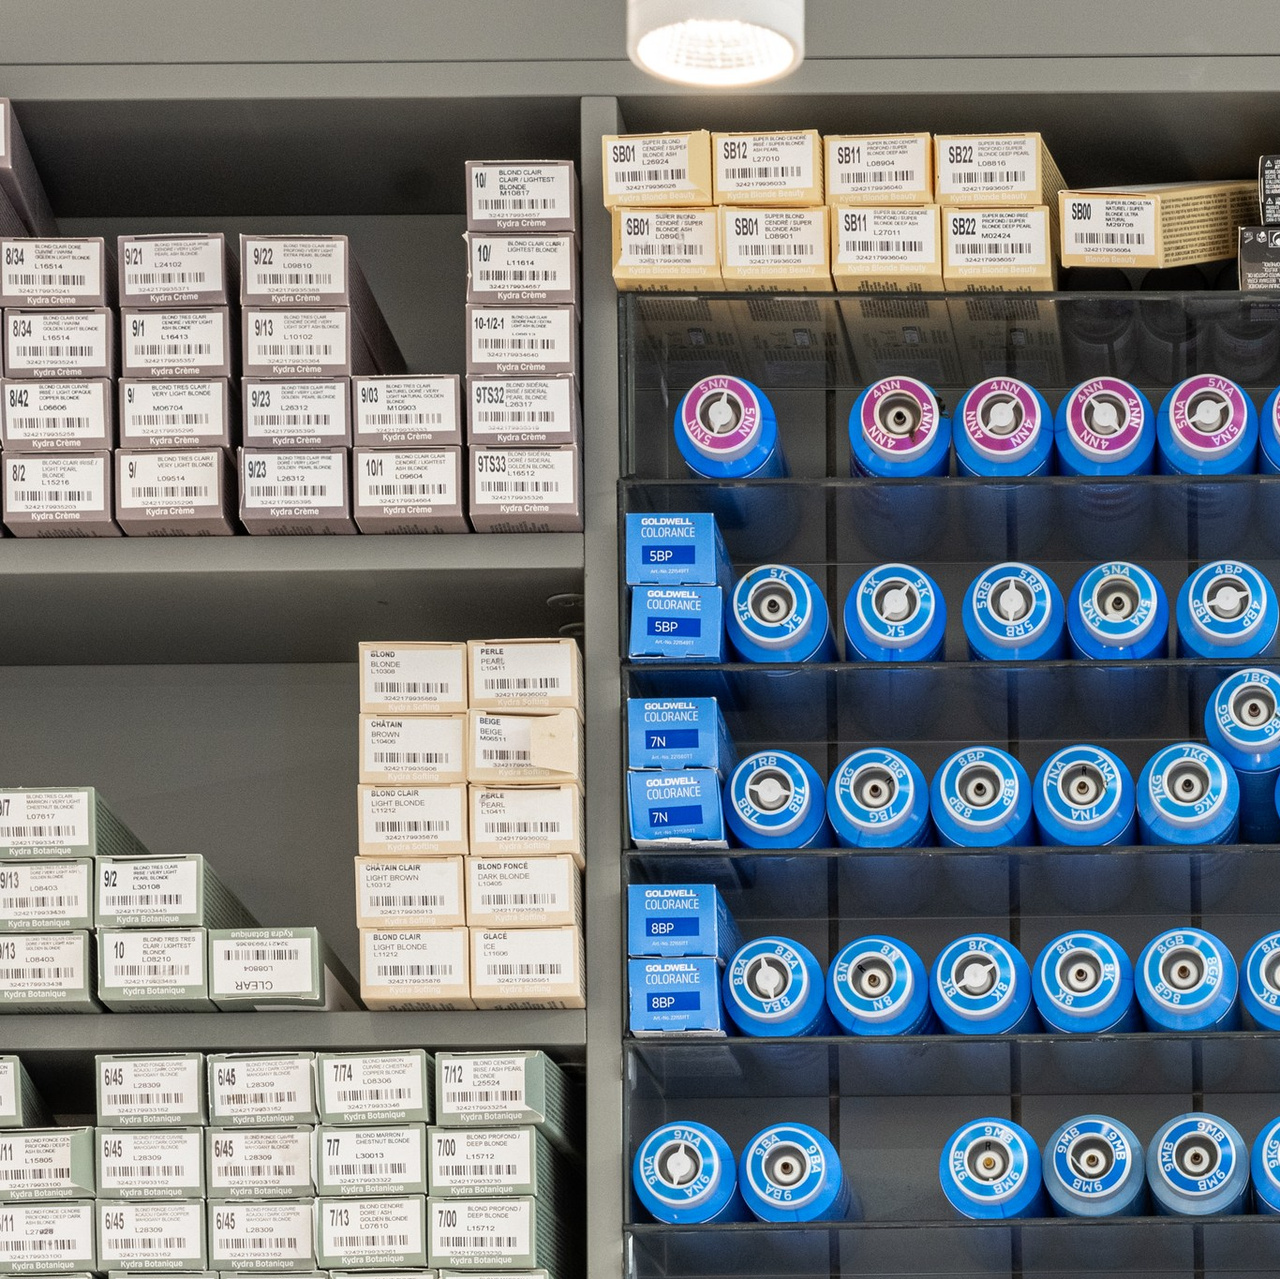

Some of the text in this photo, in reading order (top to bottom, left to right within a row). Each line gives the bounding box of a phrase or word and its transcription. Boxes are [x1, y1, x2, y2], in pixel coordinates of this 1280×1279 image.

[612, 145, 636, 163] SB01
[723, 141, 747, 160] SB12
[837, 146, 861, 164] SB11
[948, 146, 974, 164] SB22
[474, 173, 487, 188] 10/
[1070, 202, 1092, 220] SB00
[497, 219, 546, 228] Kydra Crème
[253, 247, 273, 265] 9/22
[12, 320, 32, 338] 8/34
[255, 319, 273, 337] 9/13
[474, 317, 505, 331] 10-1/2-1
[476, 380, 505, 403] 9TS32
[700, 378, 729, 393] 5NN
[989, 380, 1020, 394] 4NN
[1208, 377, 1236, 390] 5NA
[360, 387, 378, 404] 9/03
[478, 456, 507, 473] 9TS33
[641, 527, 695, 538] COLORANCE
[650, 550, 673, 562] 5BP
[480, 648, 504, 656] PERLE
[371, 719, 403, 728] CHÂTAIN
[371, 789, 419, 797] BLOND CLAIR
[104, 870, 117, 888] 9/2
[116, 914, 180, 924] Kydra Botanique
[483, 932, 508, 940] GLACÉ
[233, 980, 273, 991] CLEAR
[443, 1065, 463, 1084] 7/12
[104, 1139, 123, 1158] 6/45
[326, 1138, 340, 1158] 7/7
[438, 1210, 457, 1229] 7/00
